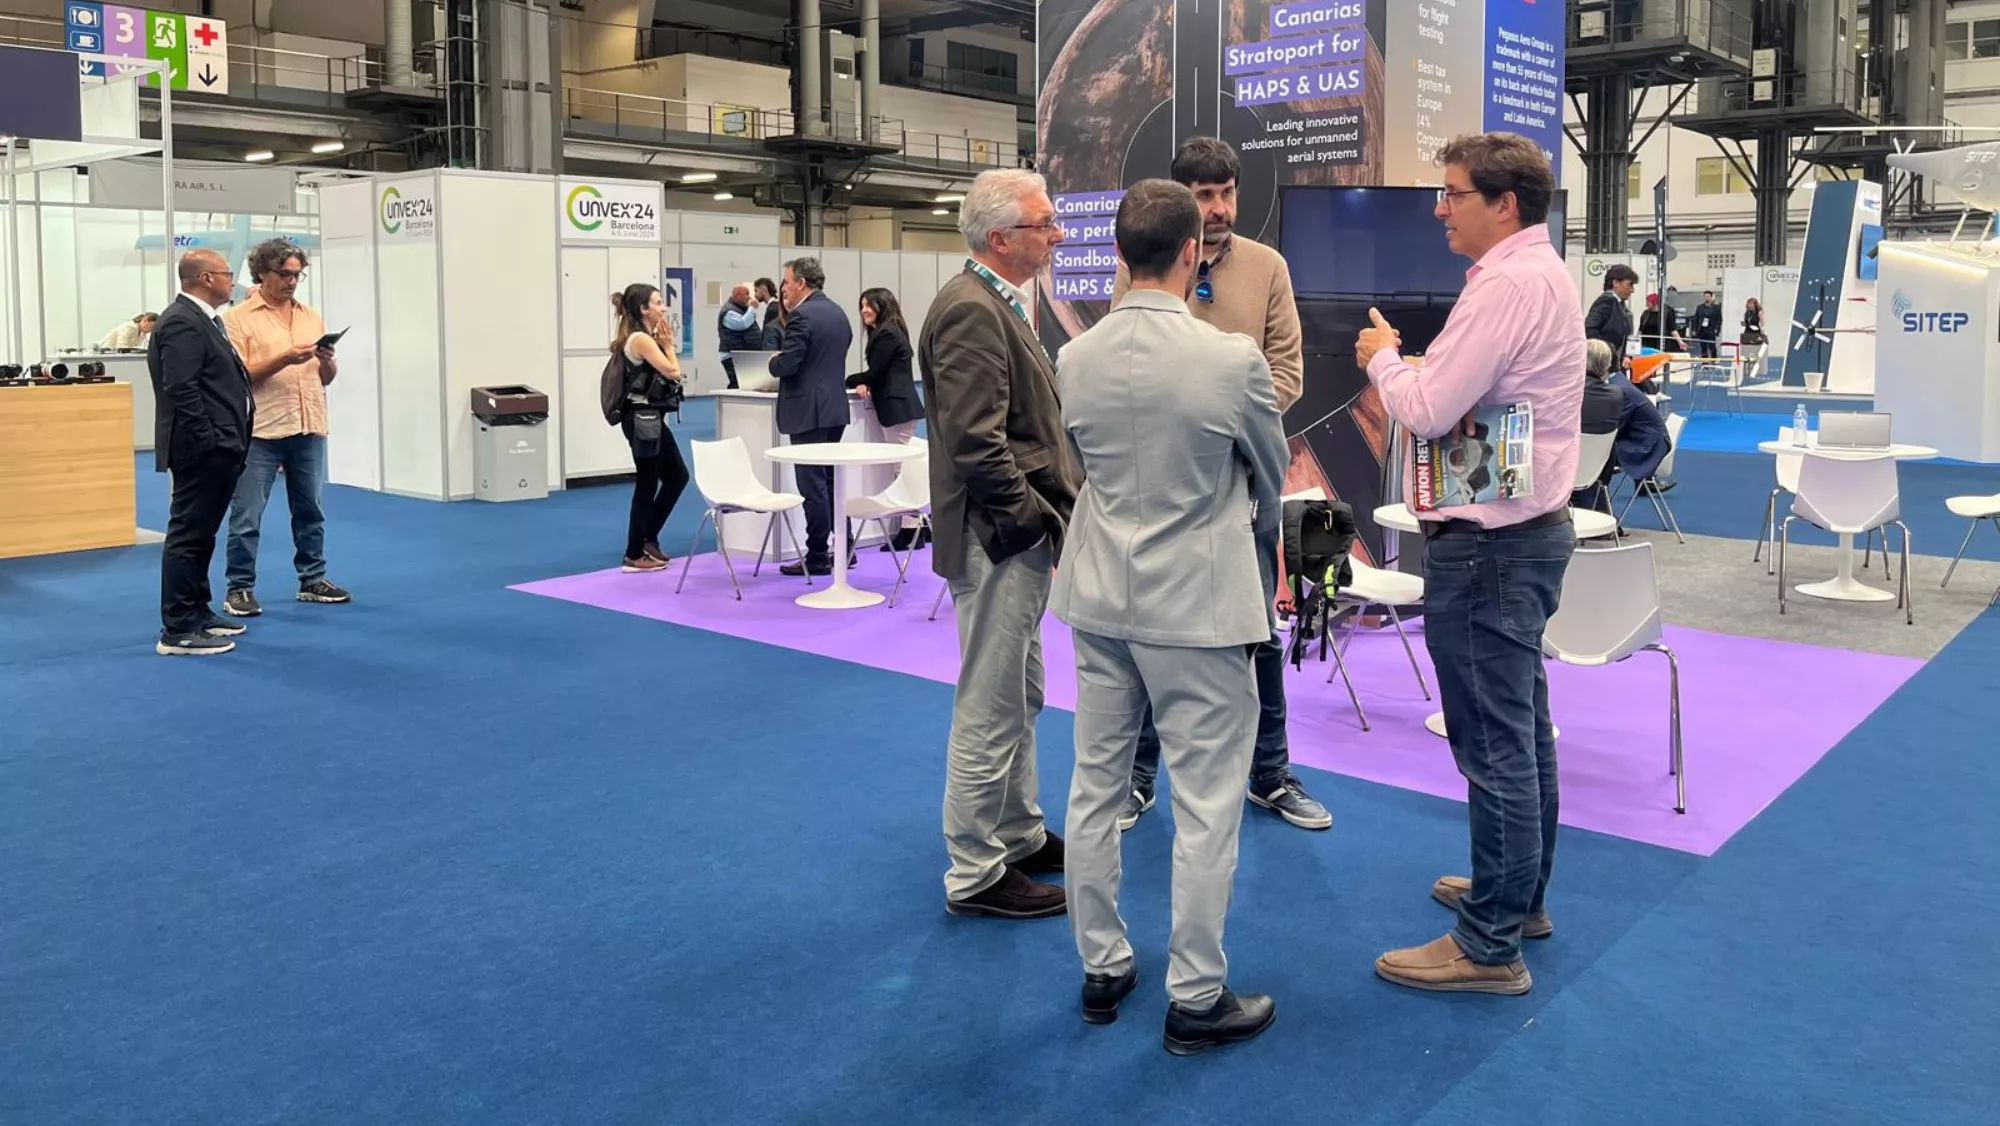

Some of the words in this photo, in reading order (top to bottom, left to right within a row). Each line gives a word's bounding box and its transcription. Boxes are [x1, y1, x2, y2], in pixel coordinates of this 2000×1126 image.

[1274, 2, 1361, 28] Canarias
[1418, 3, 1430, 19] for
[1430, 8, 1450, 27] flight
[115, 12, 135, 44] 3
[1418, 24, 1444, 45] testing
[1228, 38, 1325, 67] Stratoport
[1332, 33, 1361, 54] for
[1495, 43, 1520, 59] trademark
[1520, 50, 1531, 62] with
[1531, 36, 1545, 52] Group
[1418, 58, 1434, 75] Best
[1435, 64, 1446, 78] tax
[1505, 62, 1517, 74] than
[1524, 69, 1537, 79] years
[1238, 78, 1290, 101] HAPS
[1296, 76, 1311, 95] &
[1318, 70, 1360, 93] UAS
[1417, 77, 1444, 93] system
[1444, 80, 1451, 95] in
[1508, 78, 1520, 90] back
[1520, 83, 1530, 94] and
[1530, 84, 1543, 97] which
[1416, 93, 1442, 113] Europe
[1541, 102, 1556, 117] Europe
[1266, 119, 1304, 133] Leading
[1305, 114, 1359, 128] innovative
[1503, 110, 1513, 123] and
[1513, 111, 1526, 125] Latin
[1241, 138, 1285, 151] solutions
[1287, 135, 1303, 146] for
[1304, 129, 1359, 145] unmanned
[1287, 150, 1315, 164] aerial
[1316, 147, 1359, 164] systems
[1417, 148, 1430, 163] Tax
[1963, 151, 1998, 163] SITEP
[1054, 195, 1122, 214] Canarias
[405, 219, 433, 231] Barcelona
[610, 219, 655, 231] Barcelona
[1054, 249, 1119, 268] Sandbox
[1055, 278, 1098, 295] HAPS
[1103, 277, 1115, 295] &
[1902, 312, 1970, 333] SITEP
[1417, 438, 1430, 464] REV
[1417, 465, 1431, 508] AVION
